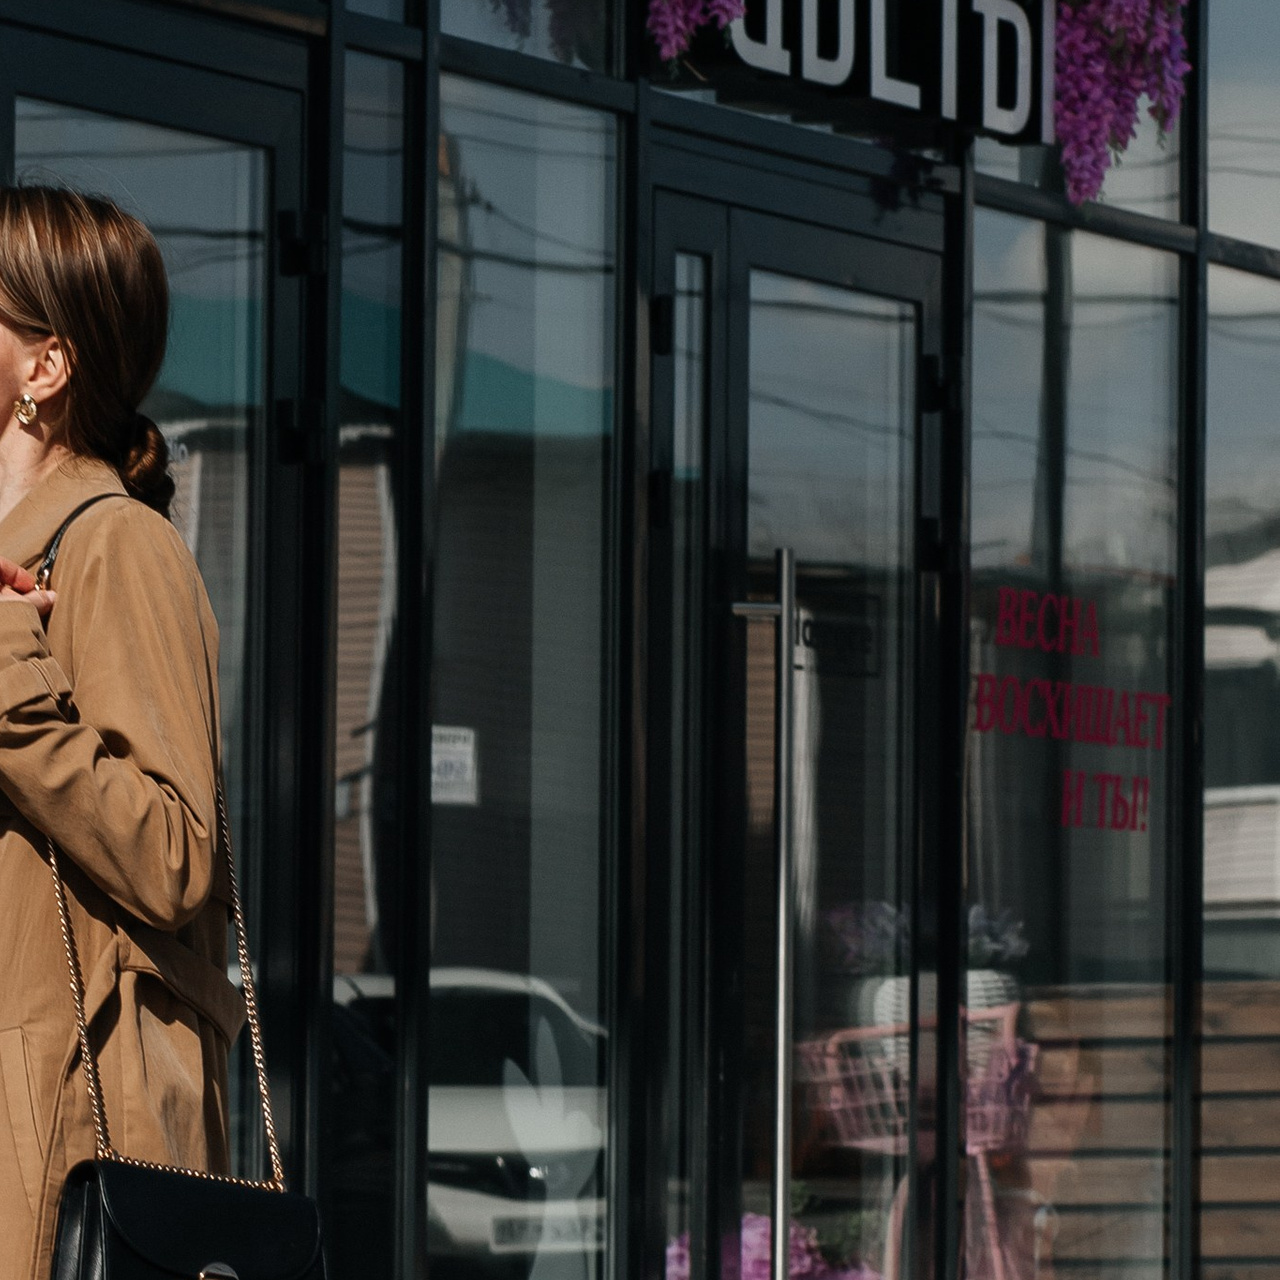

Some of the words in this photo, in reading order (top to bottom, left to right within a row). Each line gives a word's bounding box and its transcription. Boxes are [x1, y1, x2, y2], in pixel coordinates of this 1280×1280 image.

[995, 585, 1100, 658] ВЕСНА
[974, 673, 1173, 750] ВОСХИЩАЕТ
[1061, 768, 1087, 828] И
